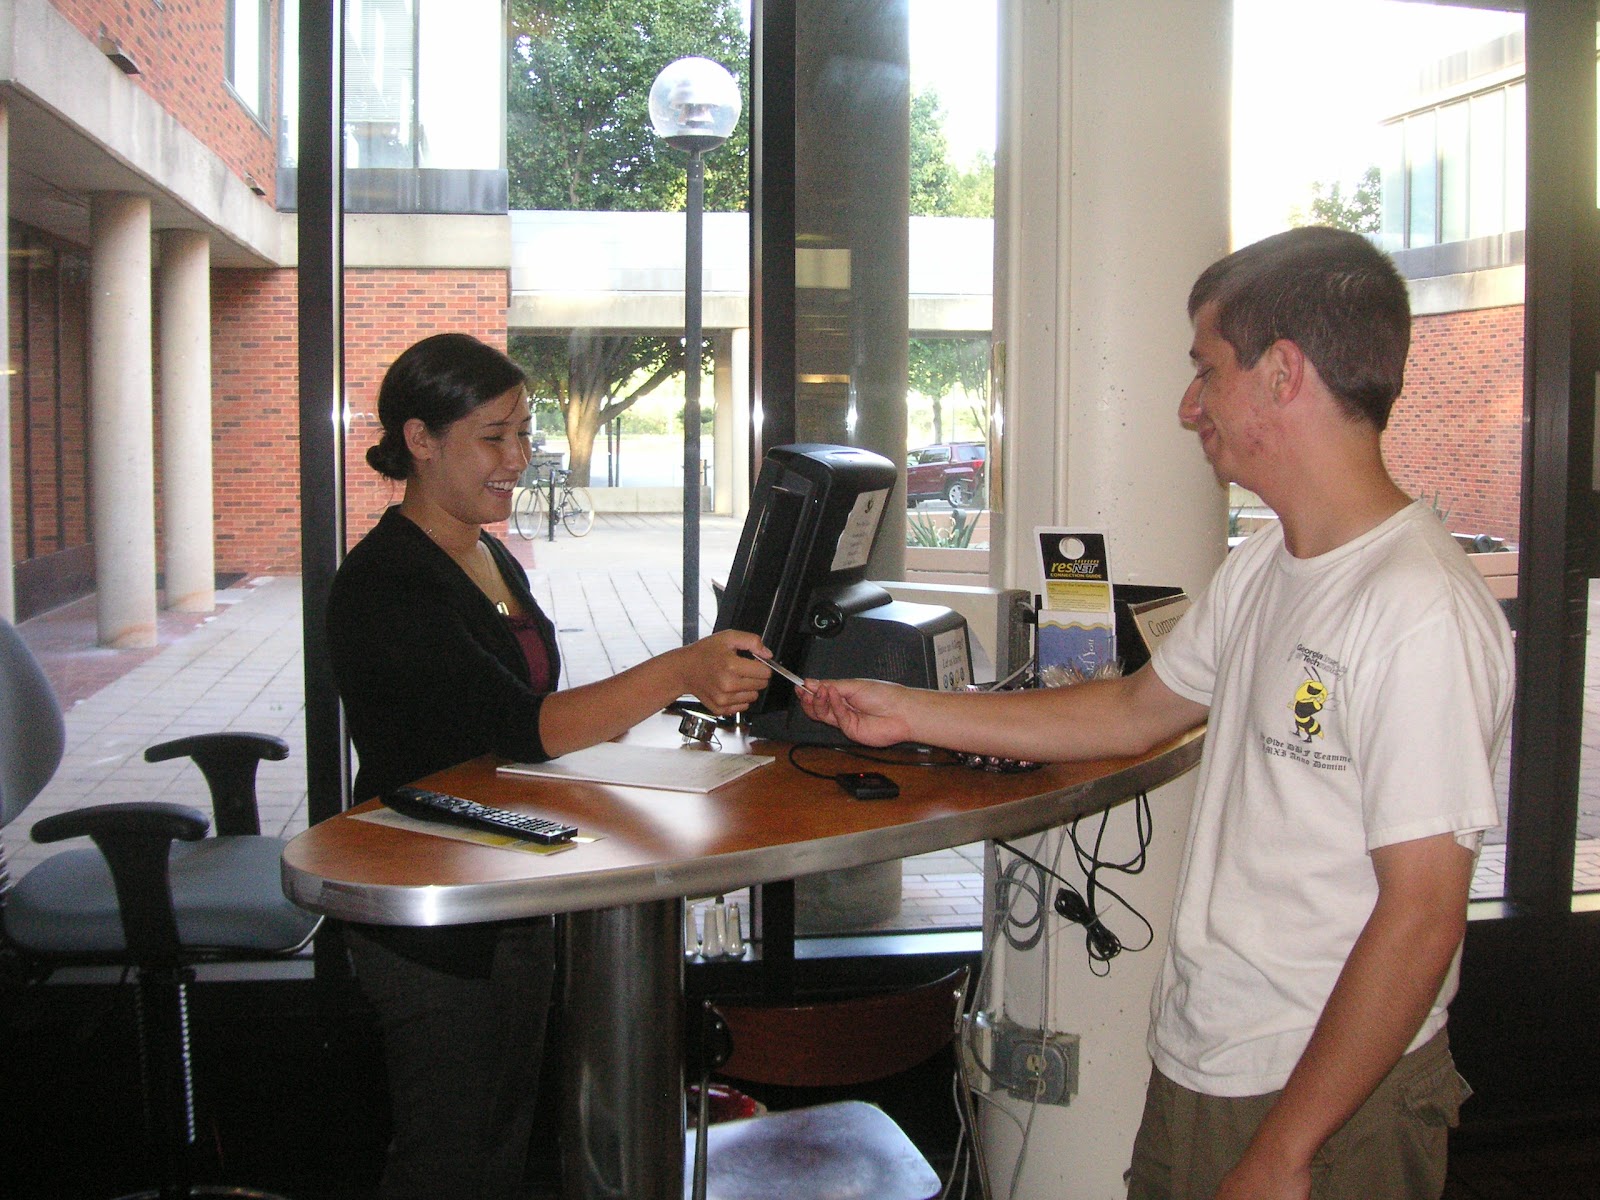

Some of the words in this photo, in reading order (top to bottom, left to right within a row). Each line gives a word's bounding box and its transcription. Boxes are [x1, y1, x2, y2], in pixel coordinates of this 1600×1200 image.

[1148, 613, 1184, 637] Comm
[1296, 643, 1324, 660] Georgia
[1265, 737, 1285, 748] Olde
[1313, 751, 1352, 763] Teamme
[1289, 751, 1310, 765] Anno
[1312, 760, 1347, 771] Domini
